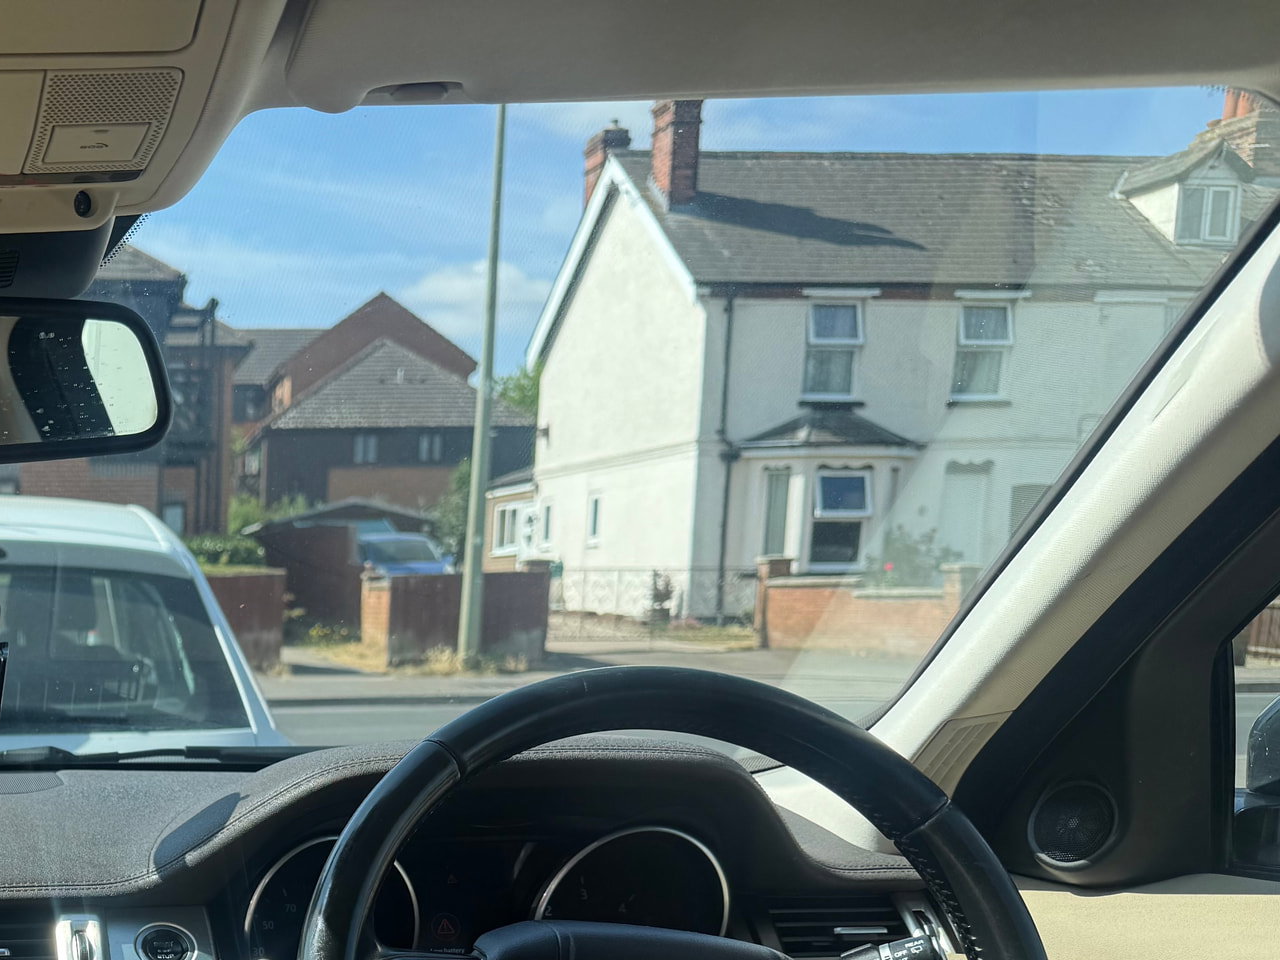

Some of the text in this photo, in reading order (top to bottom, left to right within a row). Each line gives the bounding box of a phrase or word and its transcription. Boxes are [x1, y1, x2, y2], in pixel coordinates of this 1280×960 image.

[284, 903, 297, 913] 70
[545, 906, 553, 916] 2
[262, 920, 274, 930] 50
[894, 949, 908, 958] OFF
